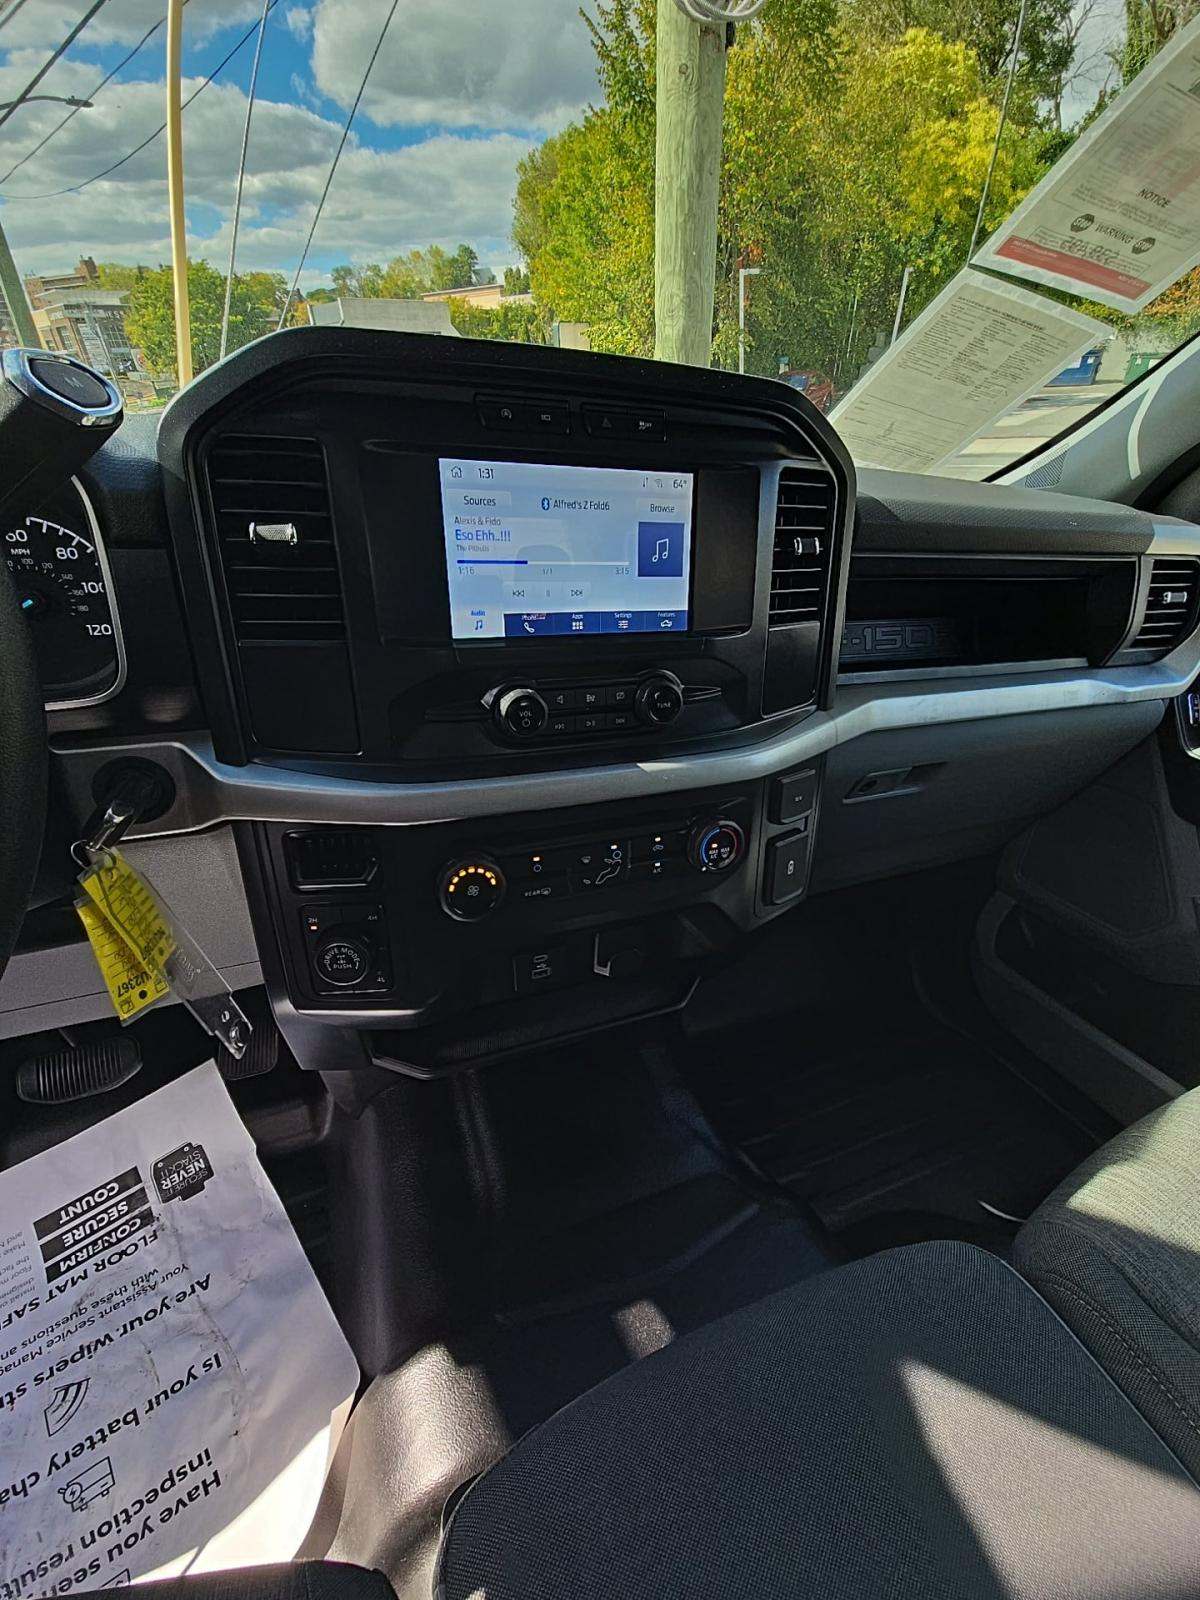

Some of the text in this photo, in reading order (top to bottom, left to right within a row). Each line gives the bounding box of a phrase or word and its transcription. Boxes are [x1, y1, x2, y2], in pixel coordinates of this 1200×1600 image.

[1138, 188, 1171, 208] NOTICE
[1095, 223, 1134, 244] WARNING
[478, 468, 494, 480] 1:31
[463, 495, 496, 507] Sources
[553, 499, 582, 510] Alfred's
[589, 501, 610, 511] Fold6
[650, 503, 675, 513] Browse
[455, 529, 473, 541] Eso
[10, 548, 30, 556] MPH
[55, 547, 79, 560] 80
[458, 567, 475, 575] 1:16
[86, 623, 112, 636] 120
[843, 625, 934, 653] -150
[160, 1158, 205, 1190] NEVER
[168, 1150, 201, 1174] STACK
[59, 1182, 119, 1224] COUNT
[61, 1201, 129, 1247] SECURE
[60, 1218, 141, 1272] CONFIRM
[0, 1229, 159, 1330] FLOOR MAT SAF
[132, 1268, 159, 1289] with
[161, 1263, 190, 1284] Your
[91, 1286, 128, 1309] these
[99, 1279, 157, 1319] Assistant
[175, 1274, 211, 1303] Are
[21, 1307, 88, 1348] questions
[46, 1315, 95, 1348] Service
[33, 1336, 114, 1387] wipers
[202, 1352, 222, 1373] Is
[144, 1365, 199, 1414] your
[46, 1407, 140, 1477] battery
[159, 1469, 222, 1523] Have
[0, 1447, 213, 1599] inspection result
[107, 1515, 154, 1562] you
